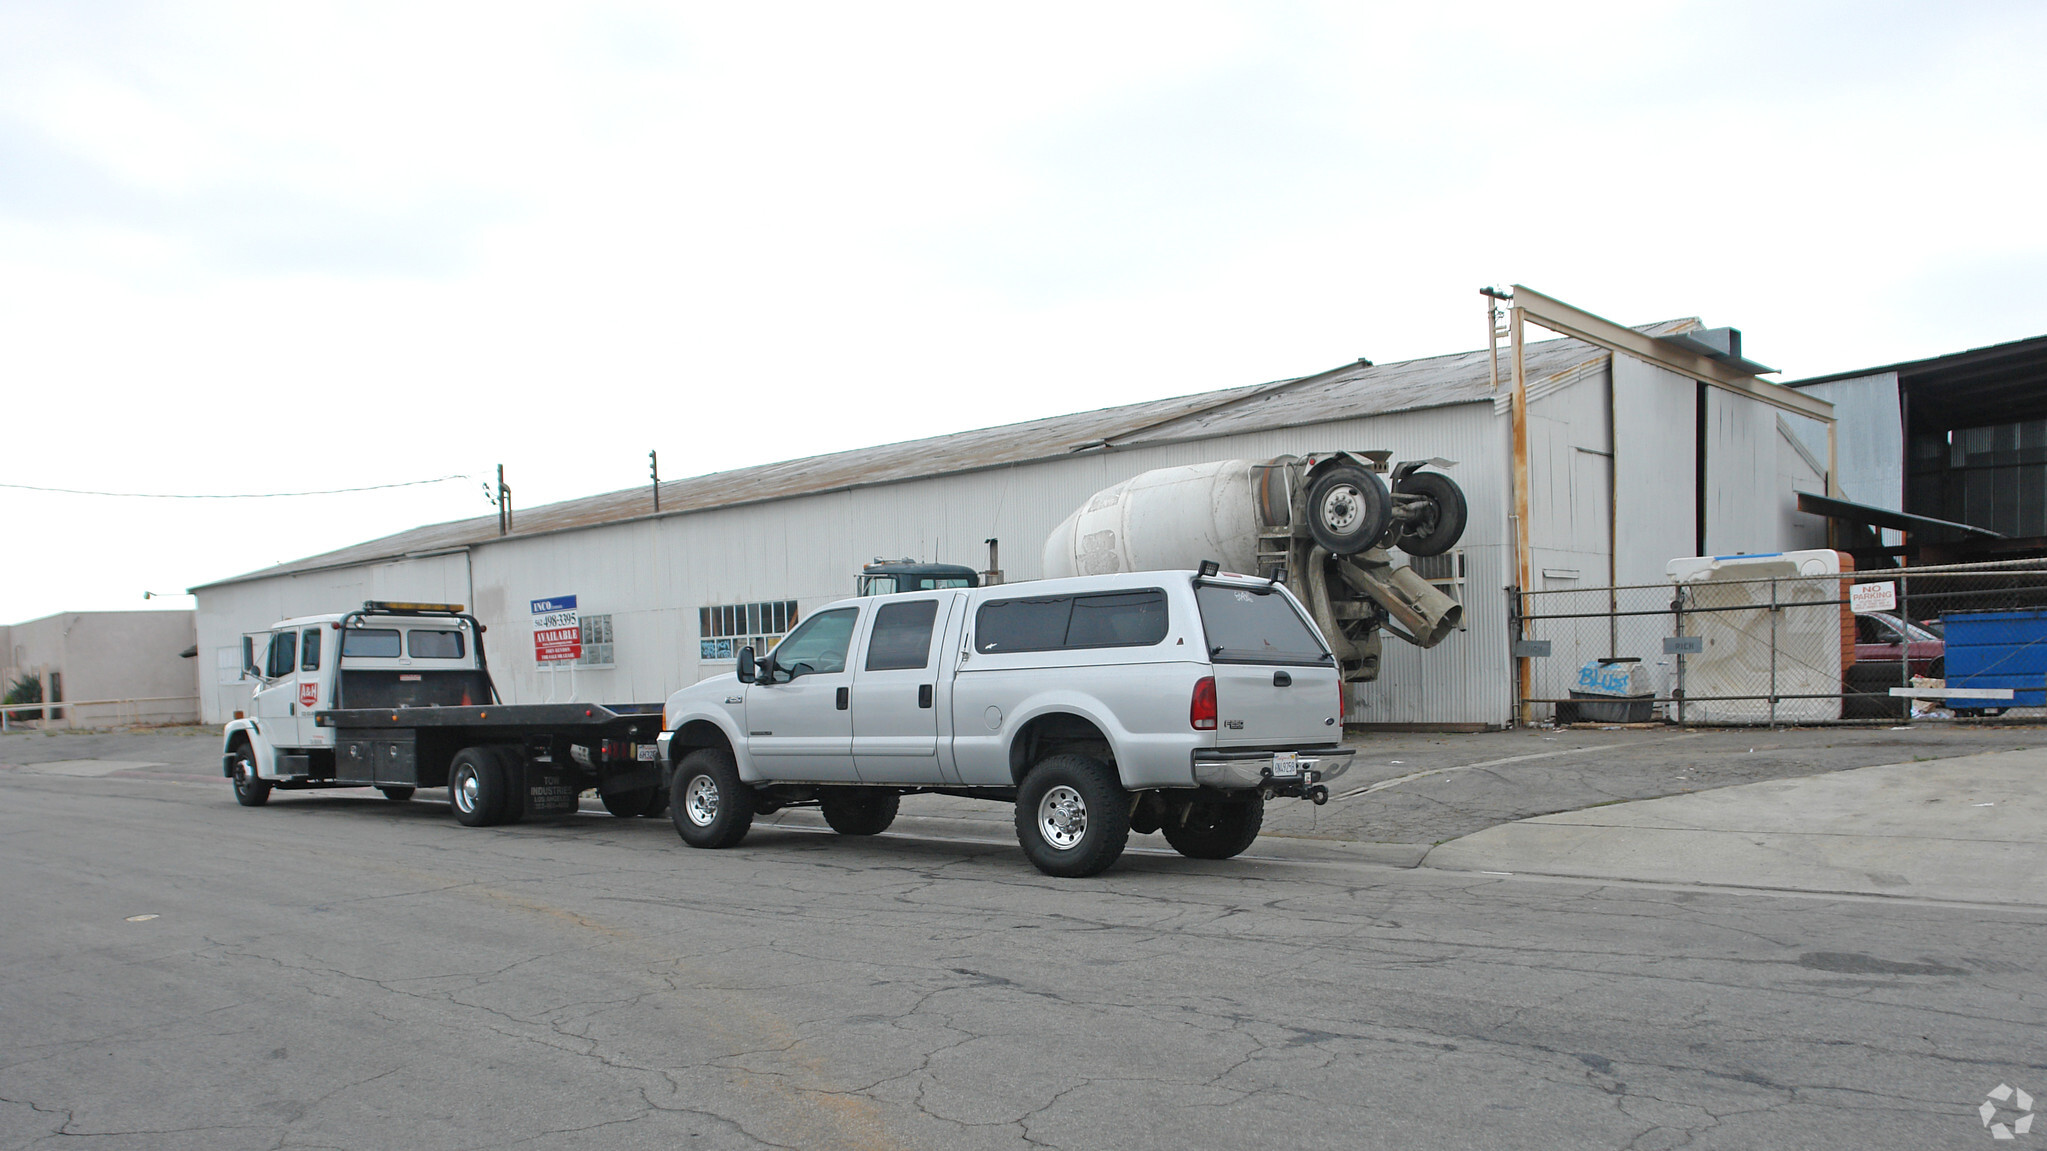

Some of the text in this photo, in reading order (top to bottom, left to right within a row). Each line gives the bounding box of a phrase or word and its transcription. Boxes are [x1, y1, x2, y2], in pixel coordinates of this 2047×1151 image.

[1862, 585, 1882, 593] NO
[1853, 591, 1892, 601] PARKING
[533, 601, 551, 612] INCO
[537, 629, 577, 642] AVAILABLE
[1675, 641, 1695, 650] RICH
[300, 684, 317, 699] A&H
[543, 776, 560, 785] TOW
[530, 785, 573, 796] INDUSTRIES
